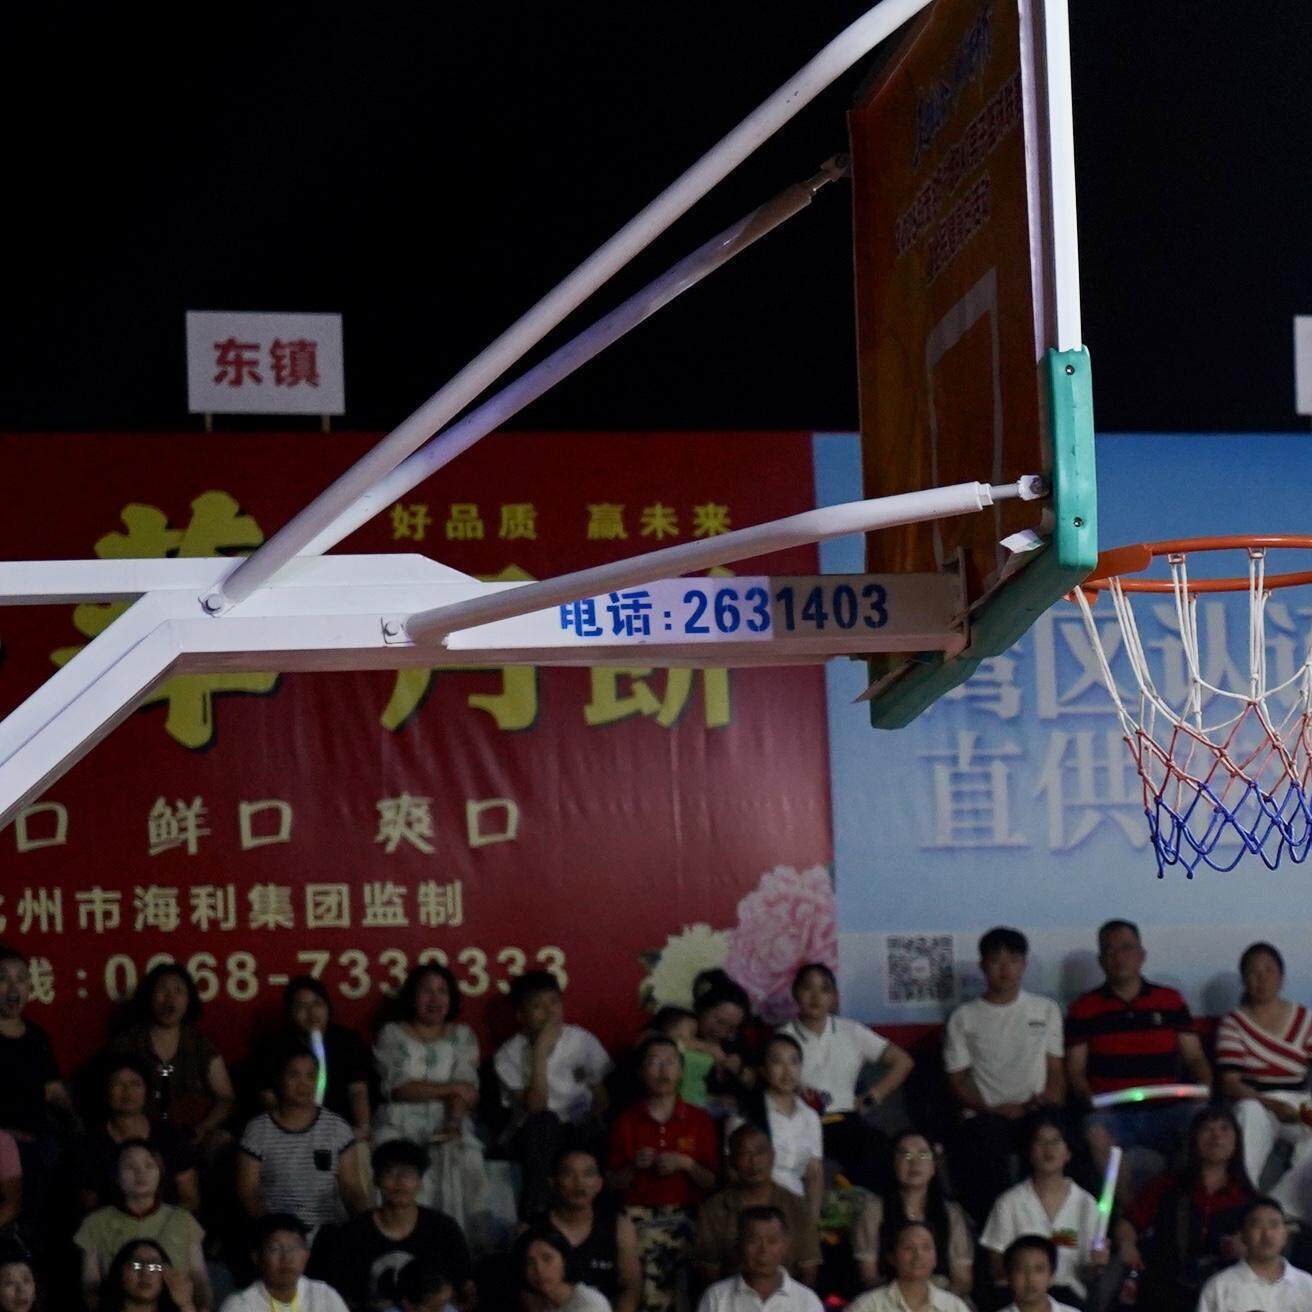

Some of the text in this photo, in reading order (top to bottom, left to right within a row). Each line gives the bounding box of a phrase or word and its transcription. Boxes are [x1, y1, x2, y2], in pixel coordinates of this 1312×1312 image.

[213, 338, 321, 388] 东镇
[391, 503, 733, 541] 好品质 赢未来
[147, 793, 294, 856] 鲜口
[374, 790, 521, 855] 爽口
[0, 879, 465, 935] 州市海利集团监制
